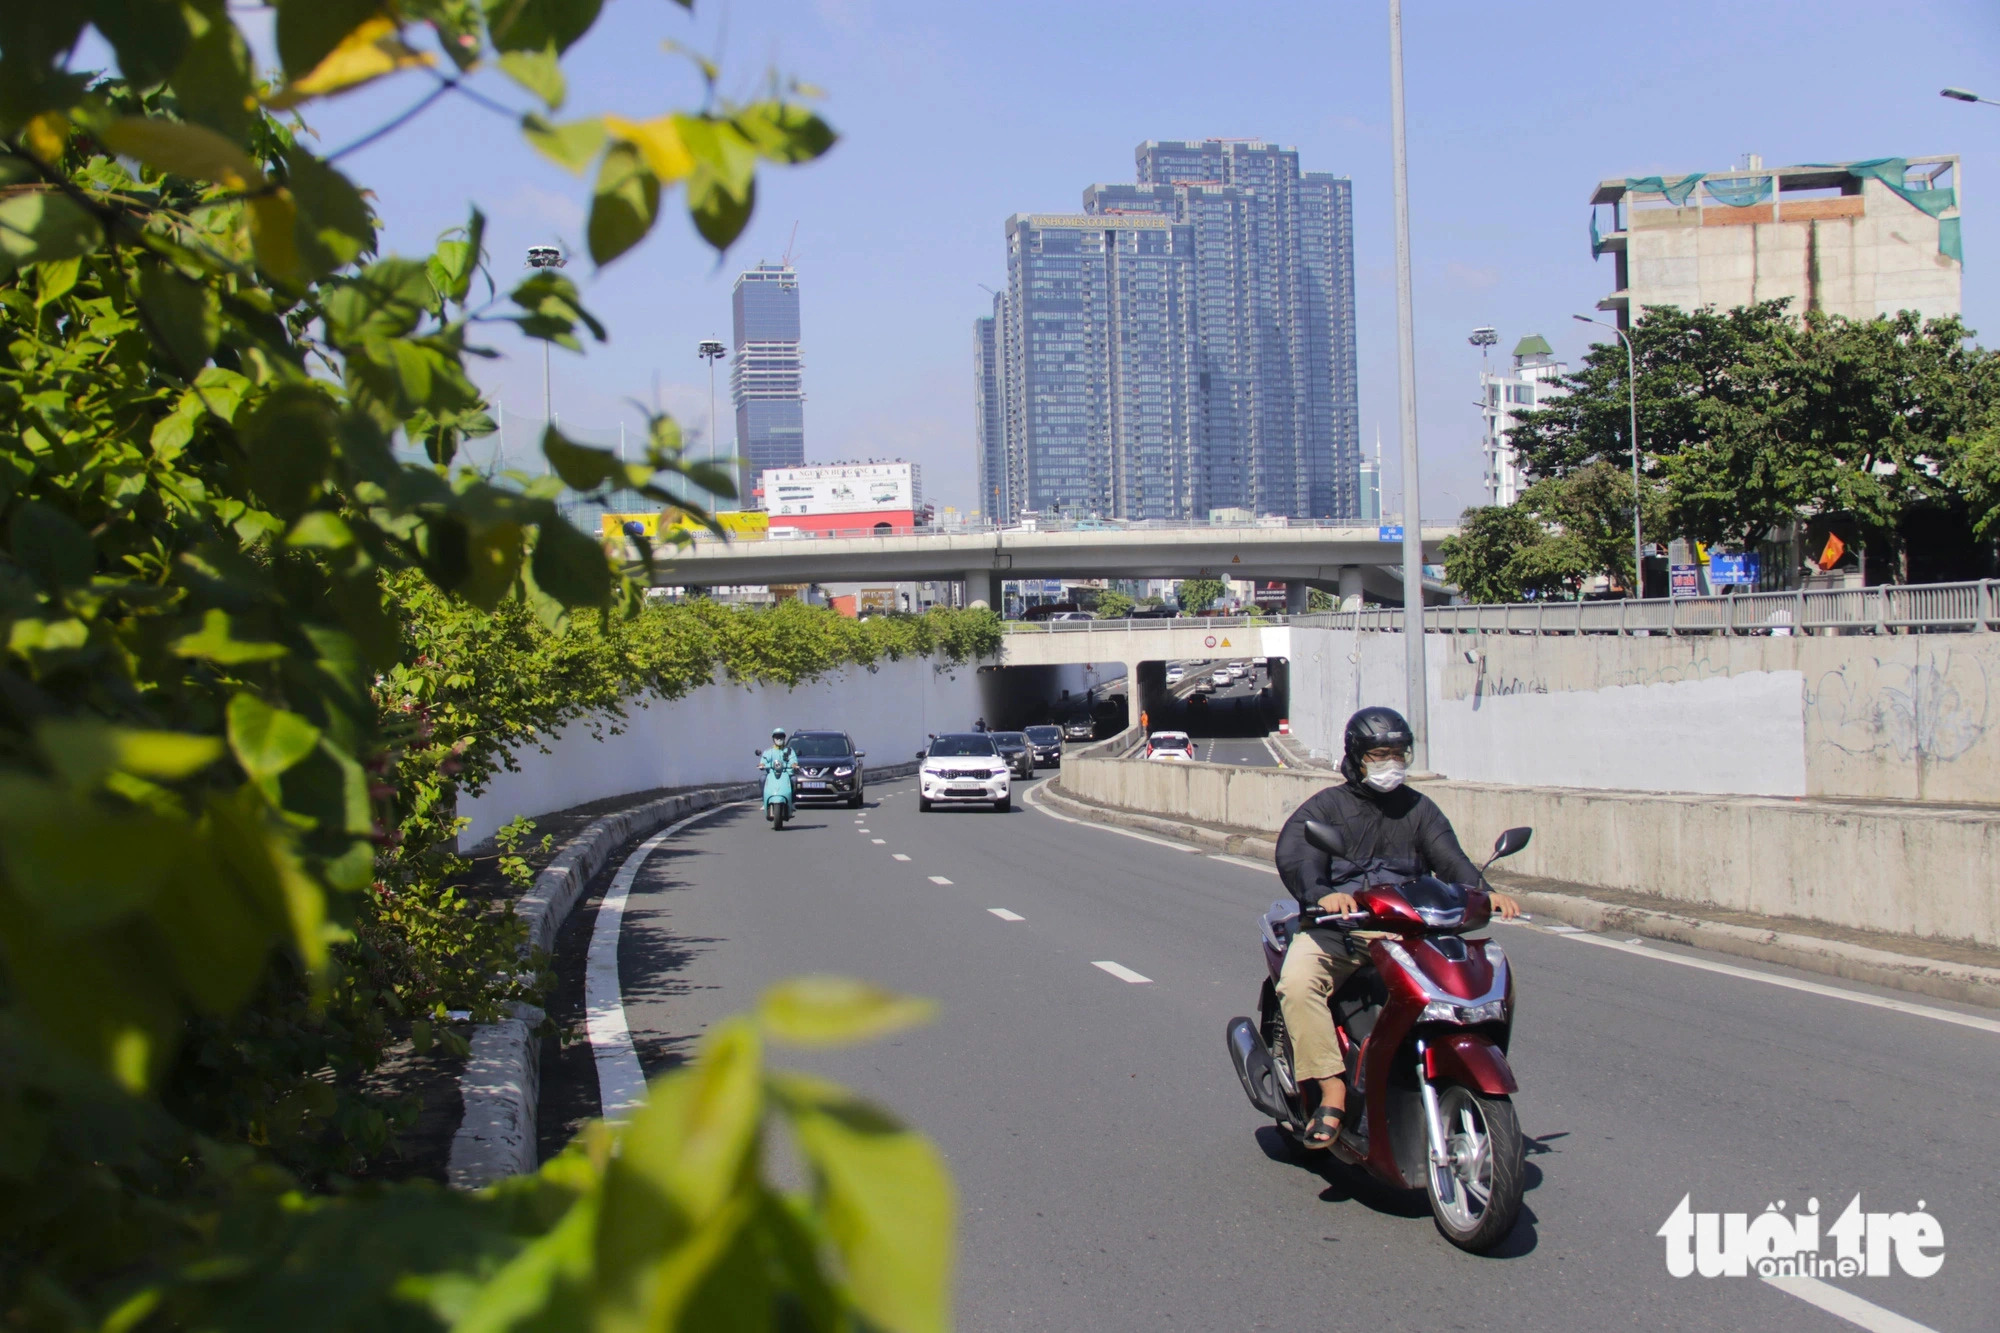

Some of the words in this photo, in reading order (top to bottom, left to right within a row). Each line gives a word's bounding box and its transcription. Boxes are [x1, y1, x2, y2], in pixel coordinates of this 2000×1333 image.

[1032, 216, 1086, 227] VINHOMES
[1087, 217, 1130, 228] GOLDEN
[1133, 218, 1166, 229] RIVER
